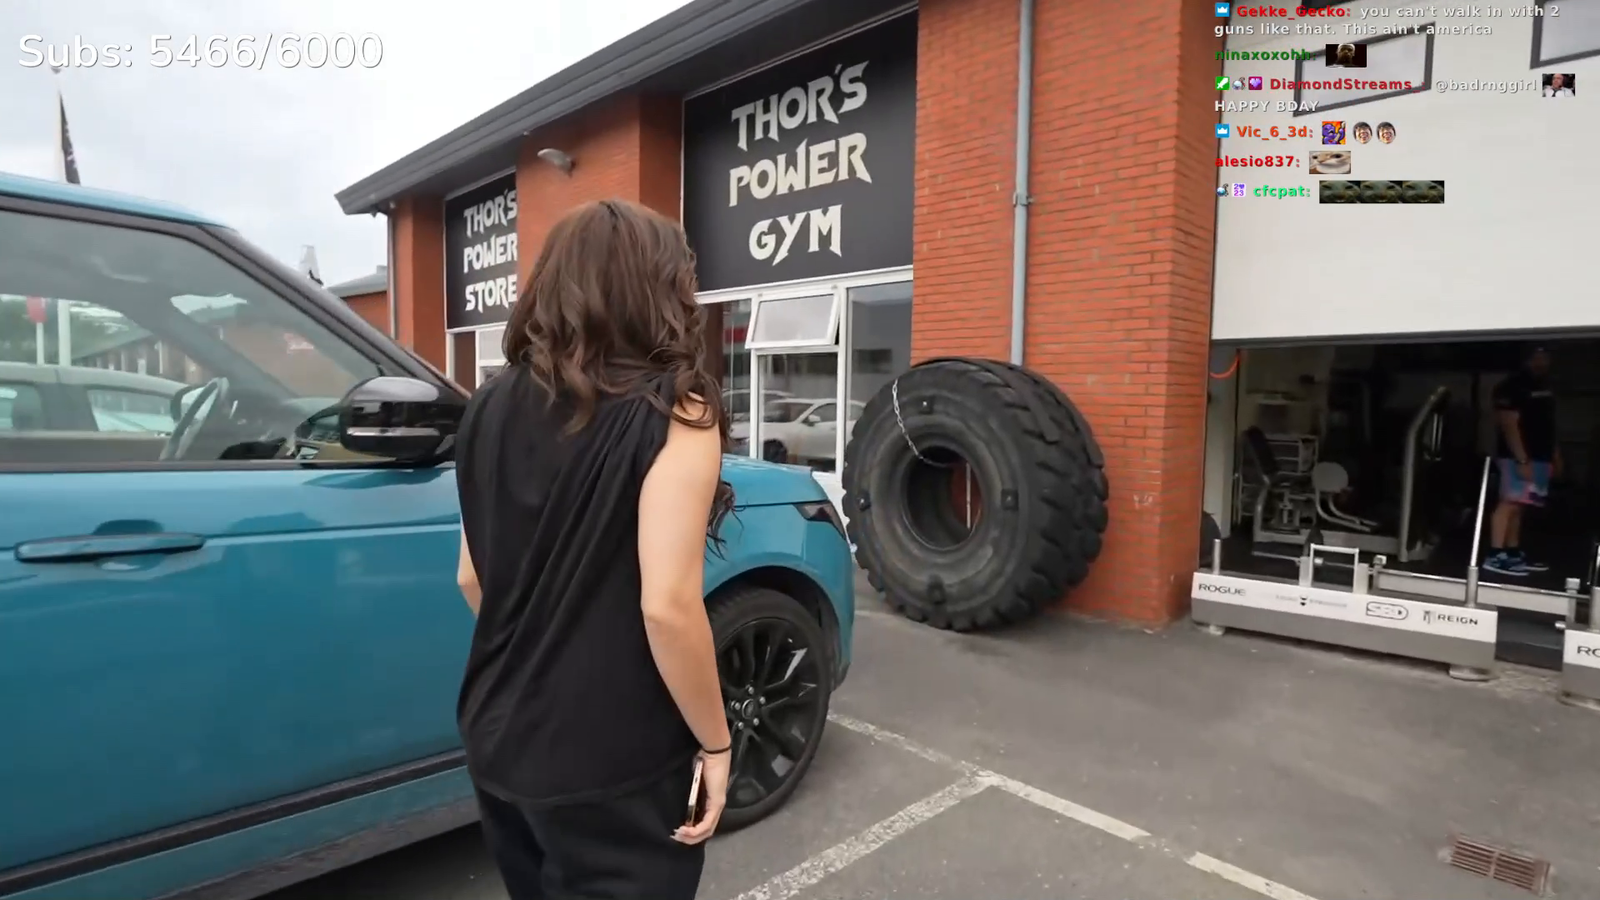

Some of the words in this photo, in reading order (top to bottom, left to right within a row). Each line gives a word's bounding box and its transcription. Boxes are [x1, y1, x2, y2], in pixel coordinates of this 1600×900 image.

[731, 60, 869, 152] THOR'S
[728, 132, 872, 207] POWER
[463, 188, 518, 239] THOR'S
[748, 204, 843, 266] GYM
[463, 232, 518, 274] POWER
[465, 273, 518, 314] STORE
[1198, 583, 1246, 597] ROGUE
[1437, 613, 1479, 626] REIGN
